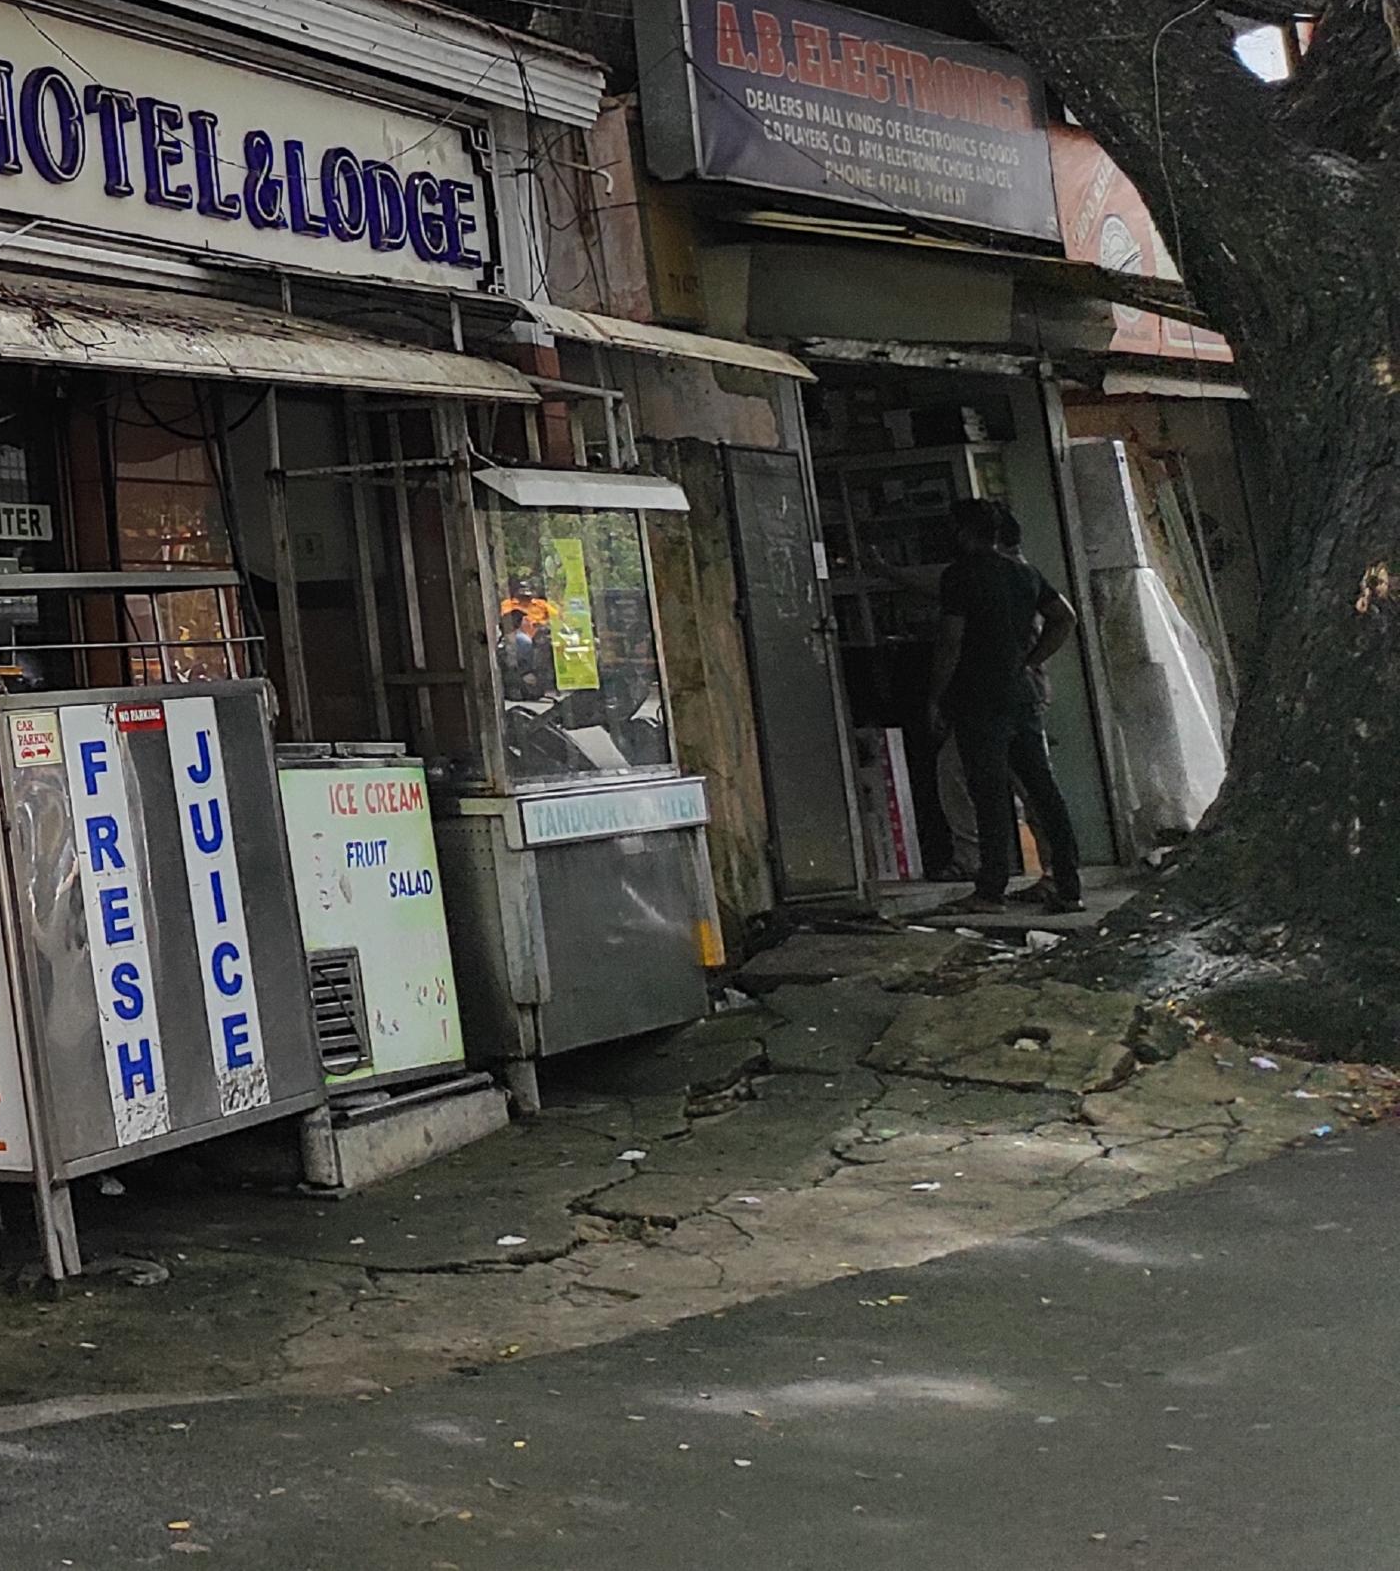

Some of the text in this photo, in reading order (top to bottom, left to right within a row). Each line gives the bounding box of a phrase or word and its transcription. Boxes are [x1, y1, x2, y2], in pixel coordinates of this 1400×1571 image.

[745, 88, 1020, 166] DEALERS IN ALL KINDS OF ELECTRONICS GOODS
[858, 139, 885, 162] ARYA
[16, 720, 34, 732] CAR
[118, 708, 161, 722] NO PARKING
[17, 732, 54, 746] PARKING
[329, 782, 424, 815] ICE CREAM
[346, 840, 388, 868] FRUIT
[389, 869, 433, 898] SALAD
[187, 730, 253, 1071] JUICE
[79, 740, 156, 1100] FRESH
